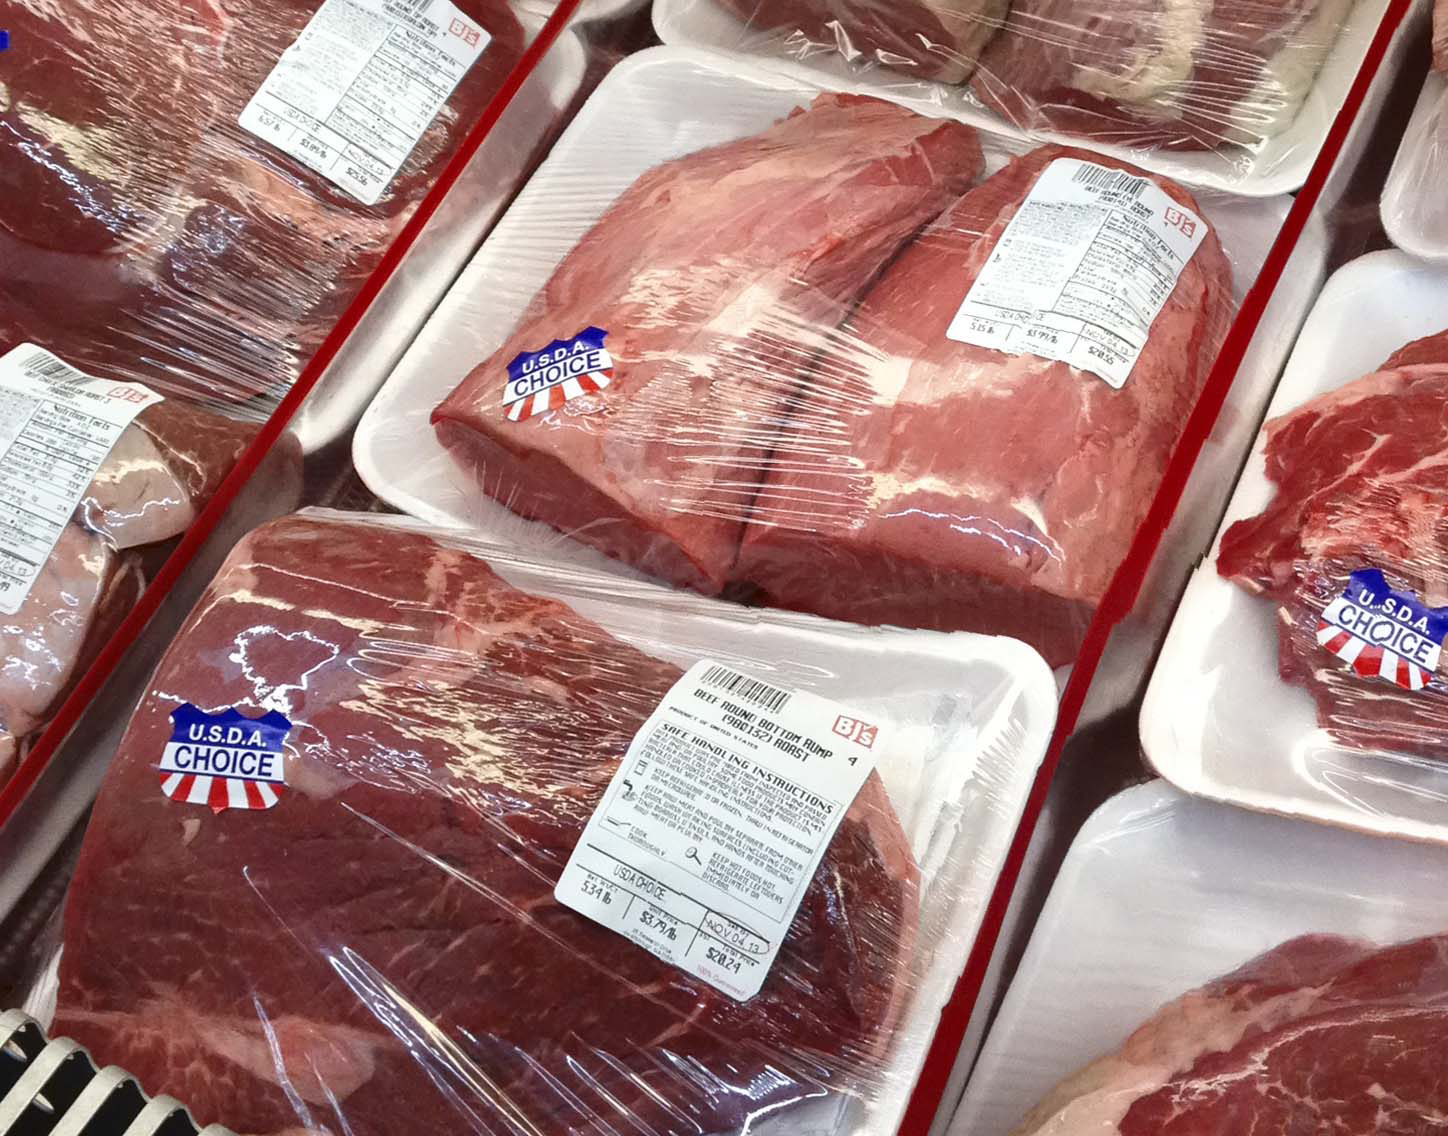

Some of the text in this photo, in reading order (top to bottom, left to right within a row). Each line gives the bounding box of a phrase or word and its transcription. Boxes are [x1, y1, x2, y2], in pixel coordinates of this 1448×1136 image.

[513, 350, 601, 397] CHOICE
[521, 340, 589, 373] U.S.D.A.
[1338, 604, 1434, 664] CHOICE
[189, 723, 267, 747] U.S.D.A.
[693, 688, 833, 760] BEEF ROUND BOTTOM RUMP
[174, 745, 275, 777] CHOICE
[773, 738, 810, 763] ROAST
[662, 722, 834, 815] SAFE HANDLING INSTRUCTIONS
[613, 864, 667, 902] USDA CHOICE
[706, 920, 729, 939] NOV
